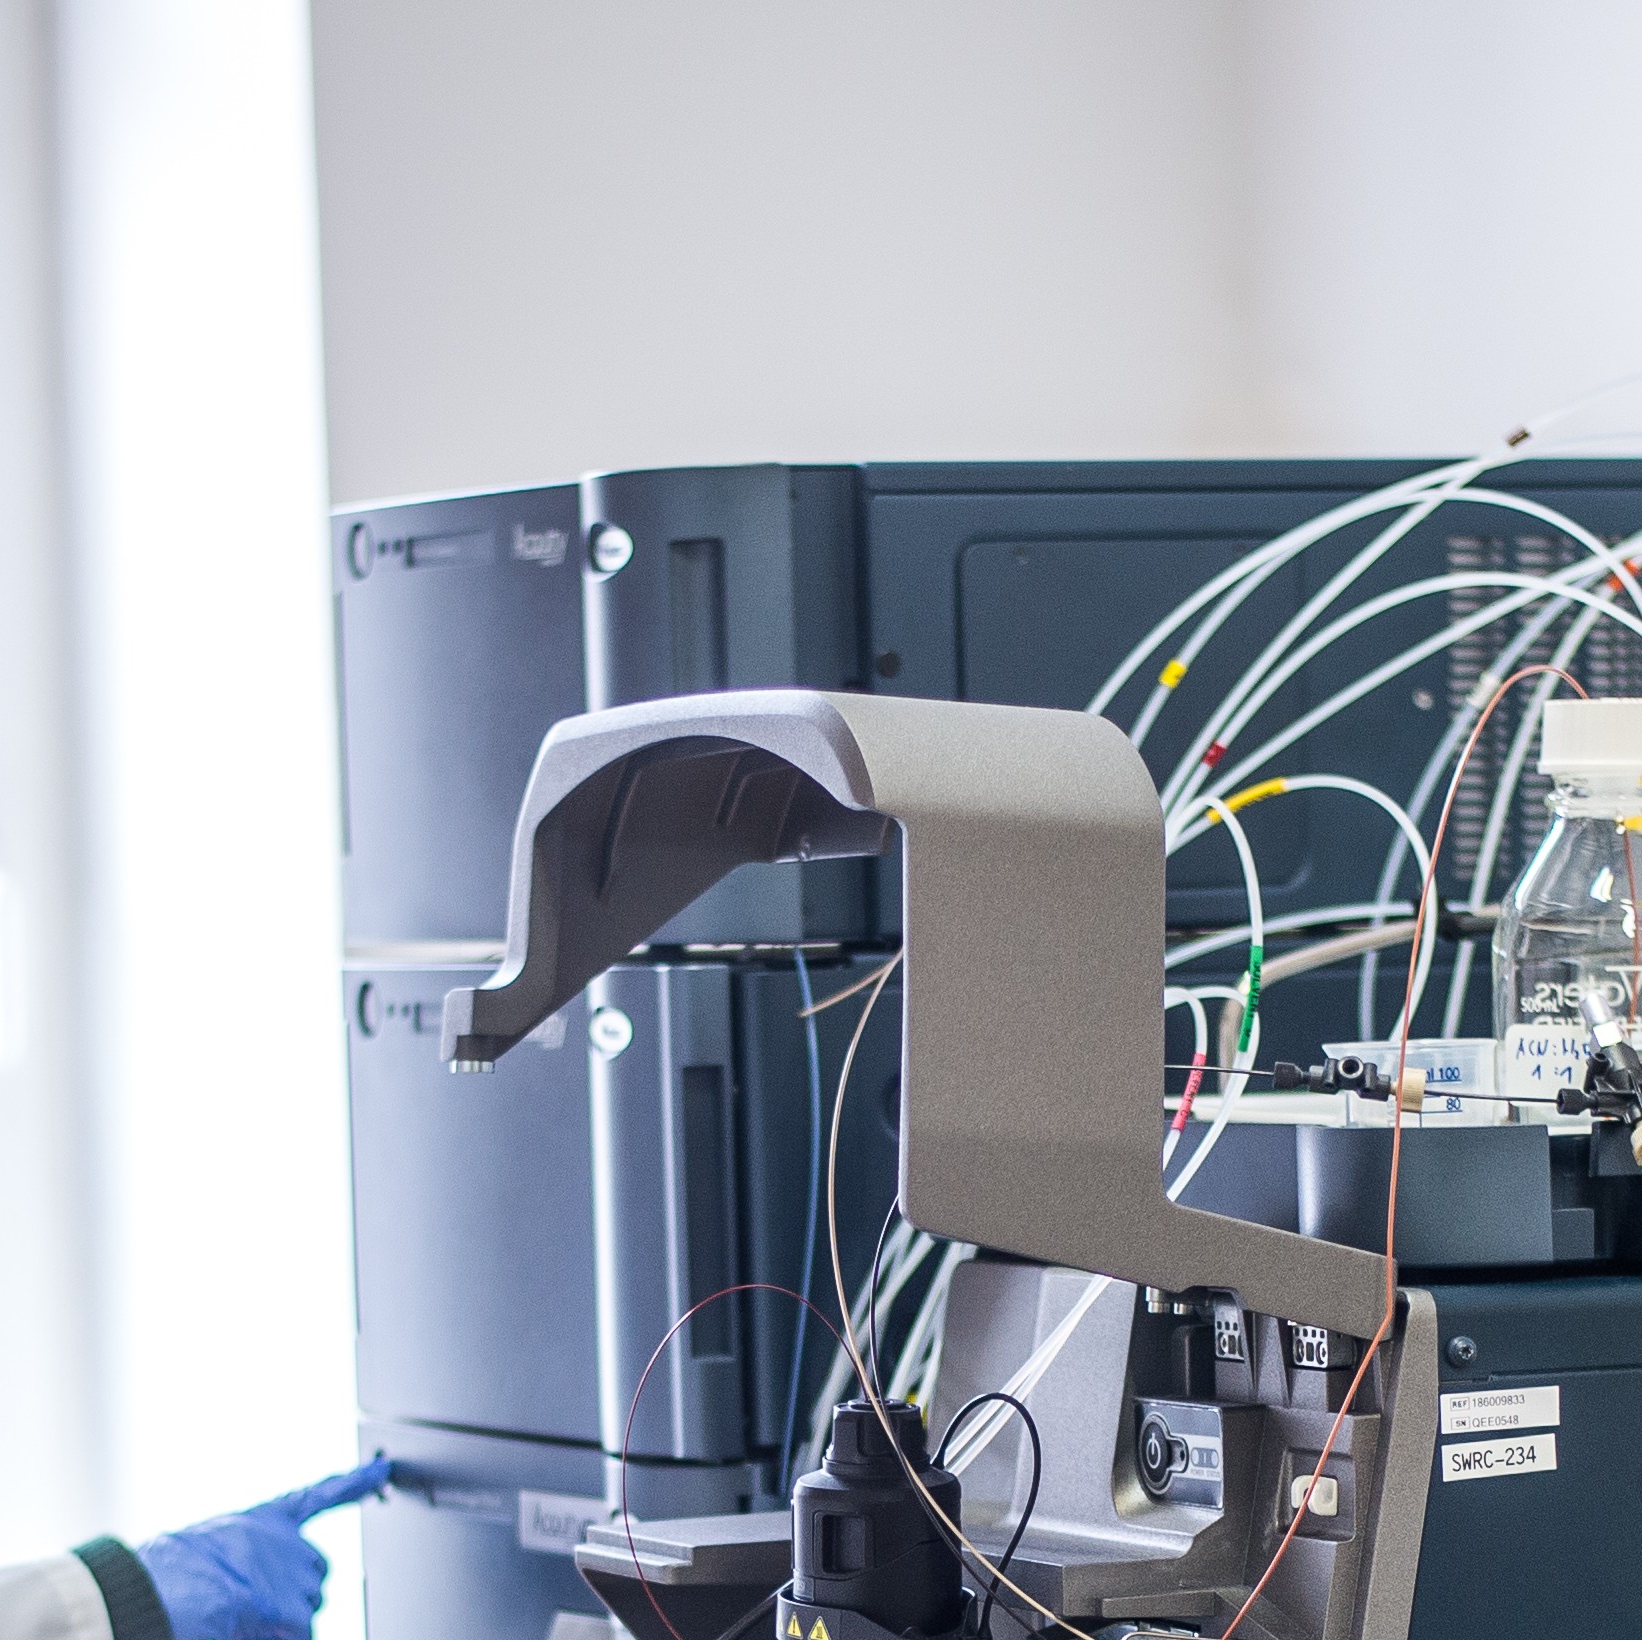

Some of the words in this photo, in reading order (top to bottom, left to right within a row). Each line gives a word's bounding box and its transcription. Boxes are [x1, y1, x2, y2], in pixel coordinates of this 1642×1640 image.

[1439, 1067, 1460, 1080] 100
[1446, 1096, 1461, 1110] 80
[1452, 1400, 1467, 1408] REF
[1472, 1394, 1525, 1408] 186009833
[1472, 1414, 1519, 1428] QEE0548
[1452, 1445, 1537, 1473] SWRC-234
